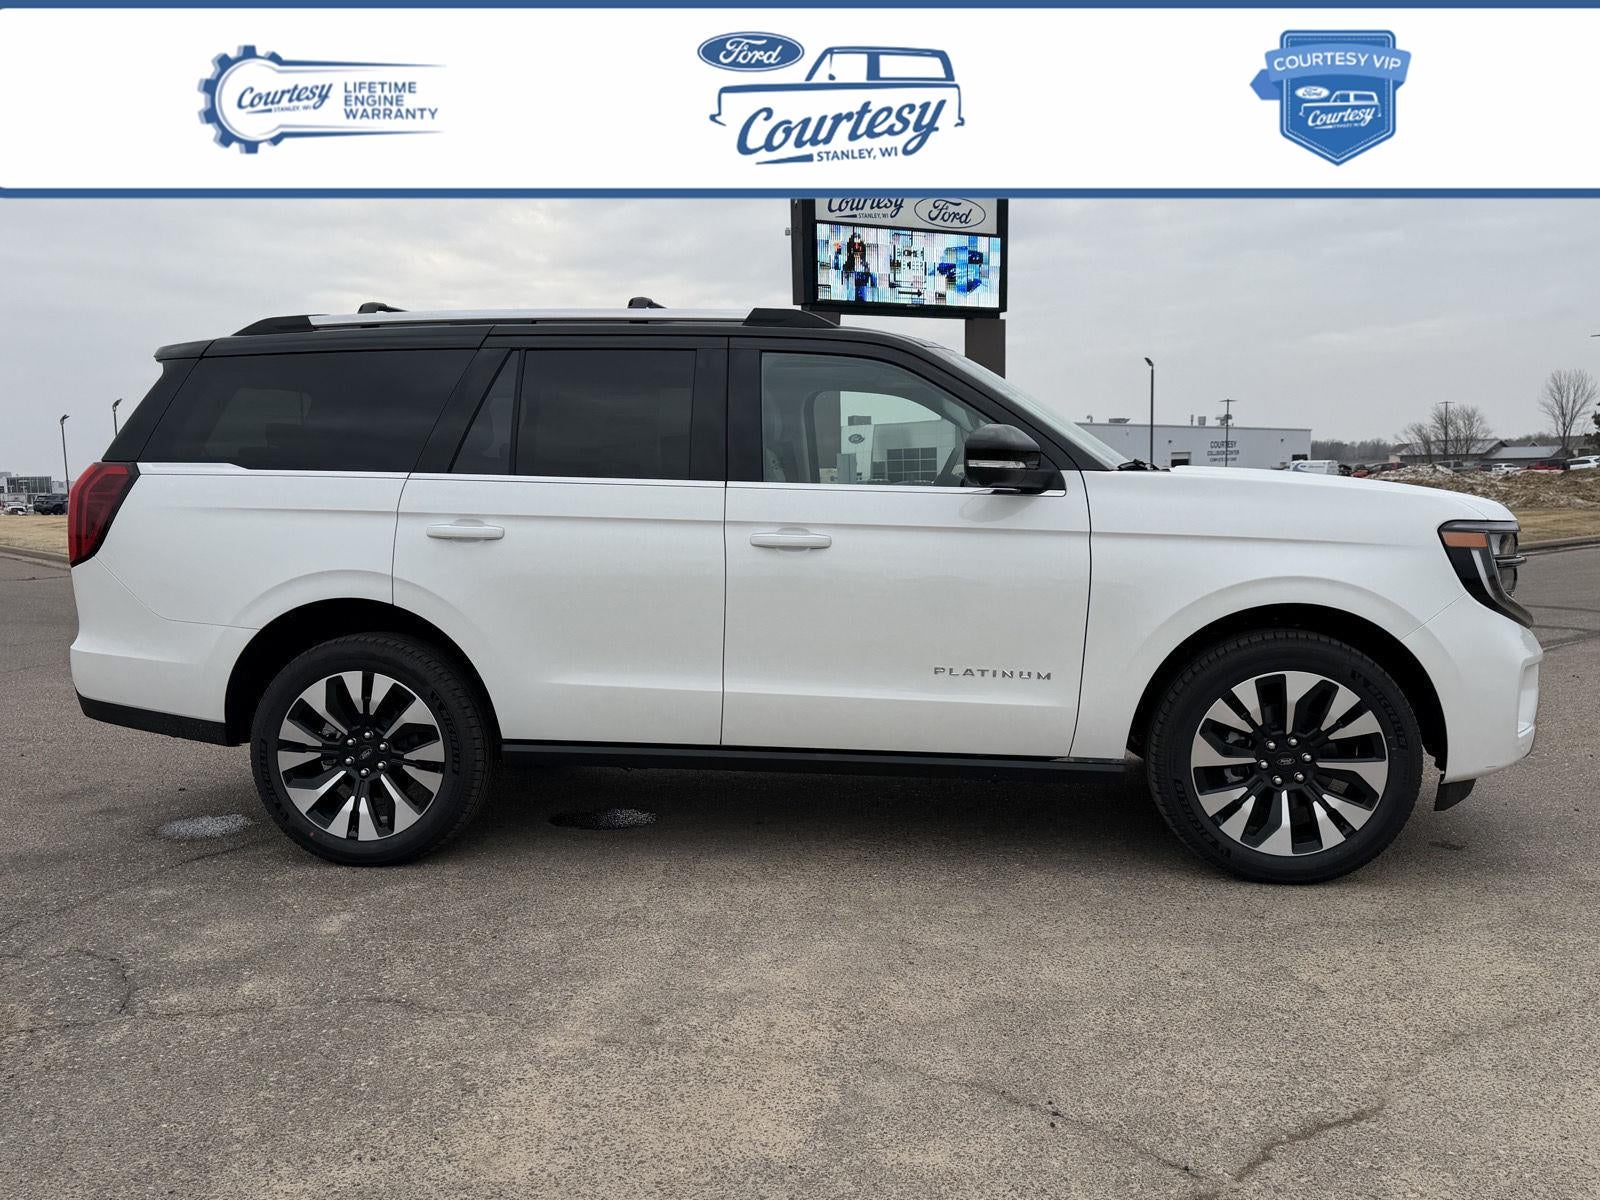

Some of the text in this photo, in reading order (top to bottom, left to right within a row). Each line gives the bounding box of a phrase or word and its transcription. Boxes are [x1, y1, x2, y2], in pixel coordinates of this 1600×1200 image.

[858, 212, 882, 220] STANLEY,
[927, 199, 973, 225] Ford
[934, 667, 1051, 680] PLATINUM
